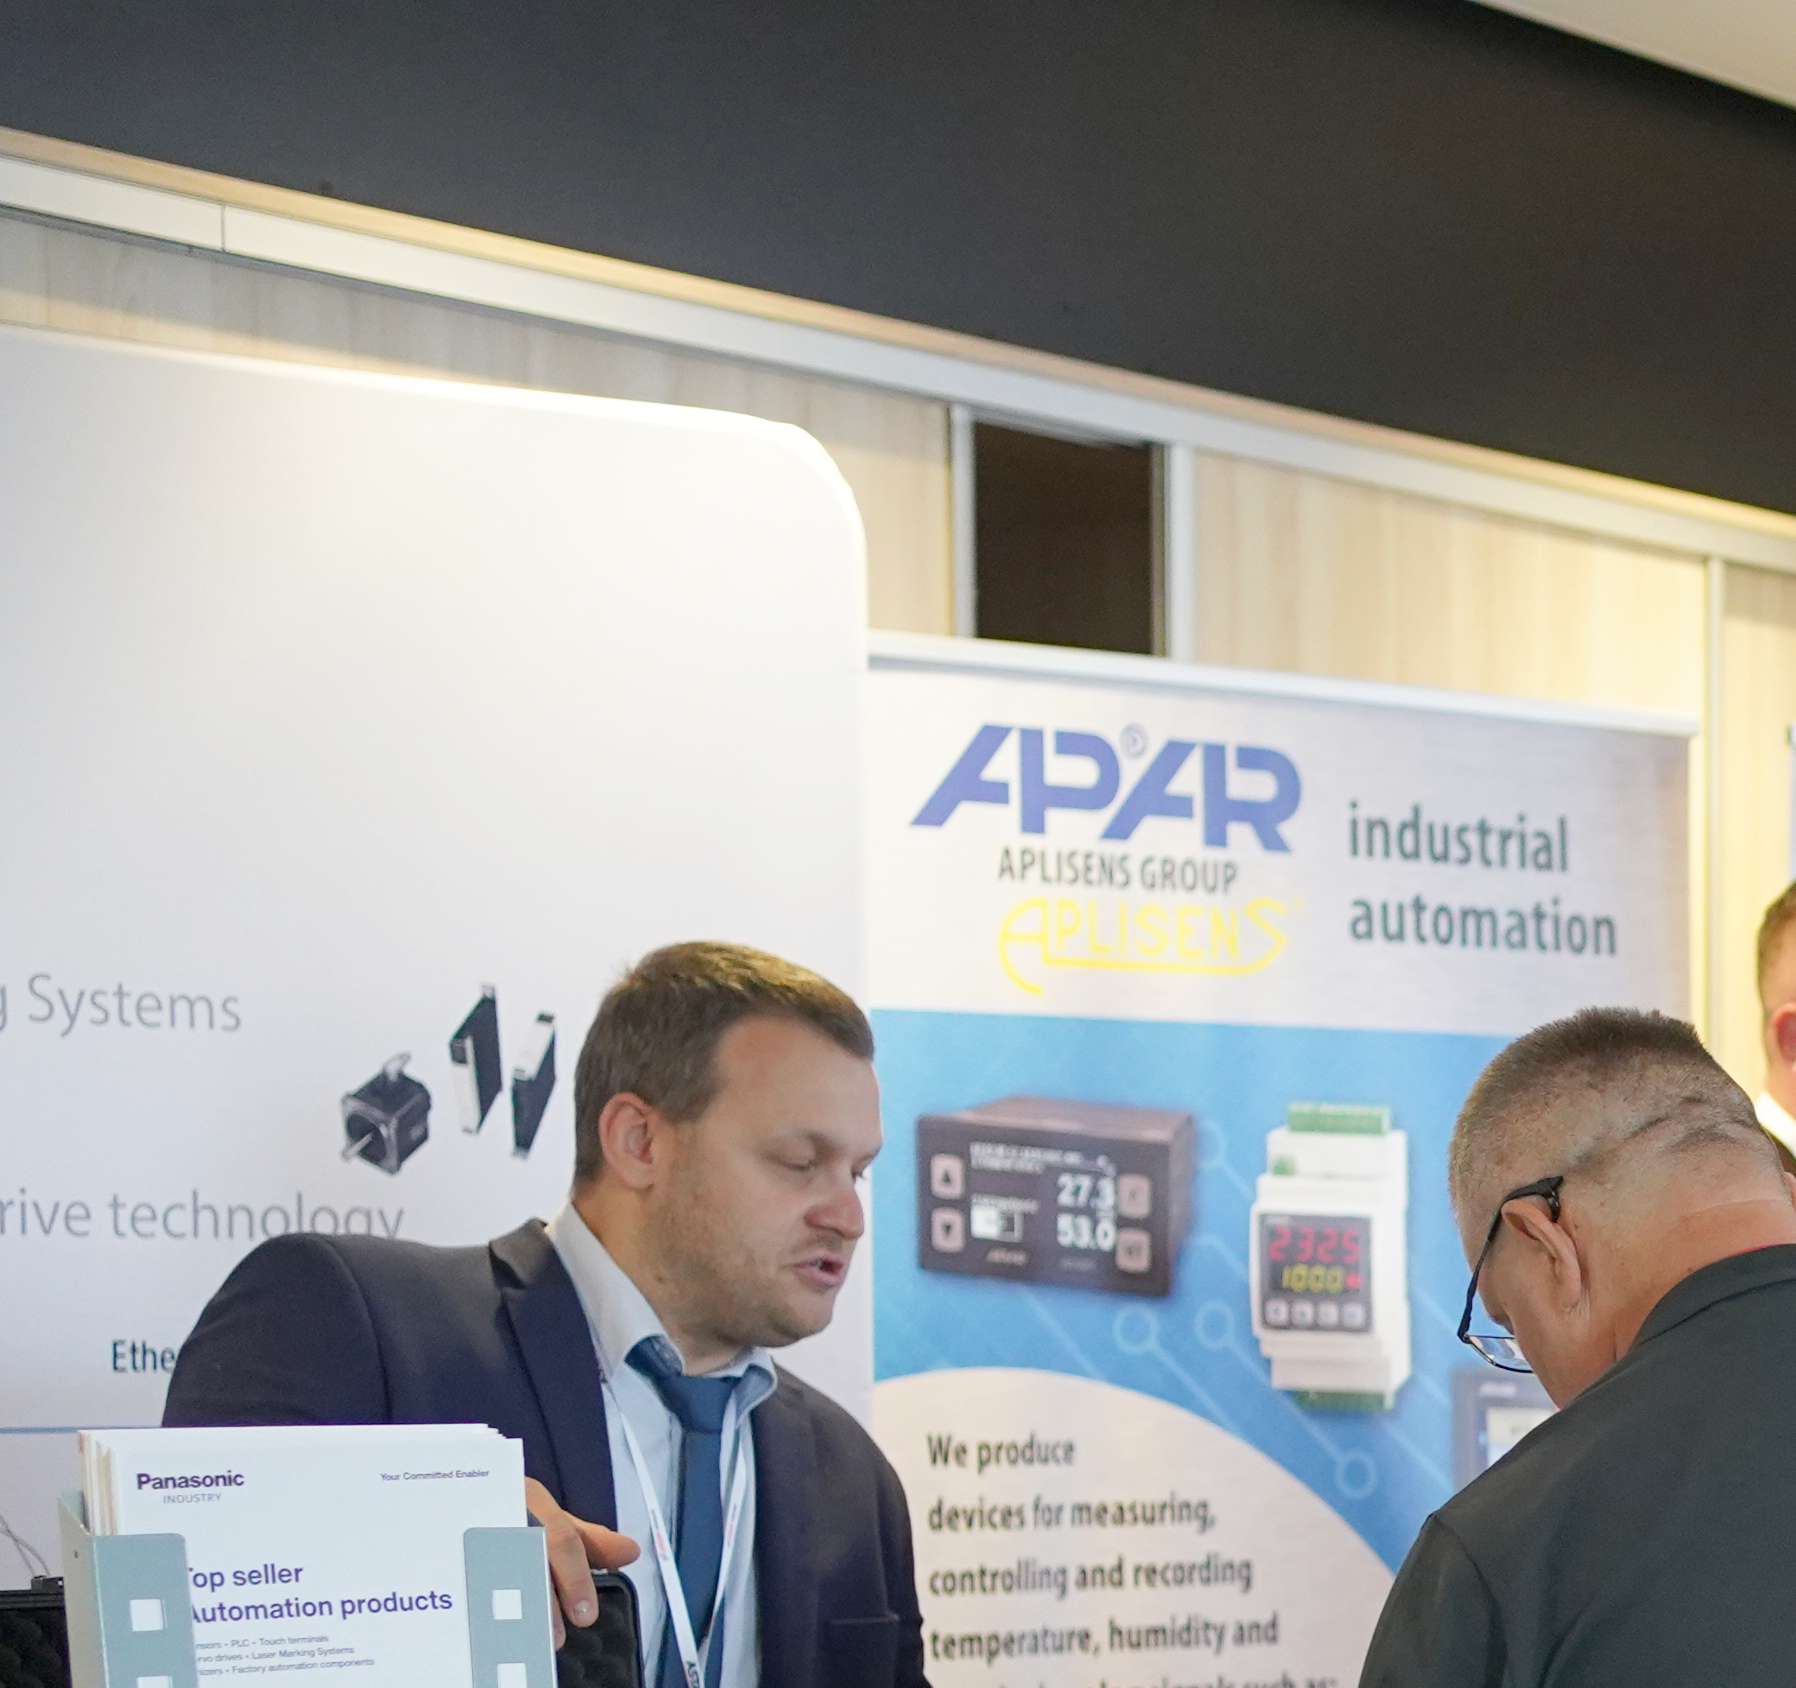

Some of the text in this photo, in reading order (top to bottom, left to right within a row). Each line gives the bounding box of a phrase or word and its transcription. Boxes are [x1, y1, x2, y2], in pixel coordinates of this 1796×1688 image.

[910, 724, 1302, 855] APAR
[1348, 800, 1570, 874] industrial
[998, 845, 1240, 896] APLISENS GROUP
[1000, 897, 1288, 995] APLISENS
[1350, 893, 1618, 957] automation
[28, 972, 243, 1037] Systems
[0, 1188, 92, 1236] rive
[112, 1340, 176, 1373] Ethe
[380, 1468, 490, 1482] Your Committed Enabler
[928, 1431, 1075, 1475] We produce
[136, 1469, 245, 1490] Panasonic
[163, 1492, 222, 1504] INDUSTRY
[928, 1491, 1215, 1533] devices for measuring,
[188, 1563, 304, 1593] op seller
[929, 1553, 1254, 1600] controlling and recording
[341, 1591, 453, 1621] products
[259, 1636, 286, 1647] Touch
[930, 1612, 1280, 1667] temperature, humidity and
